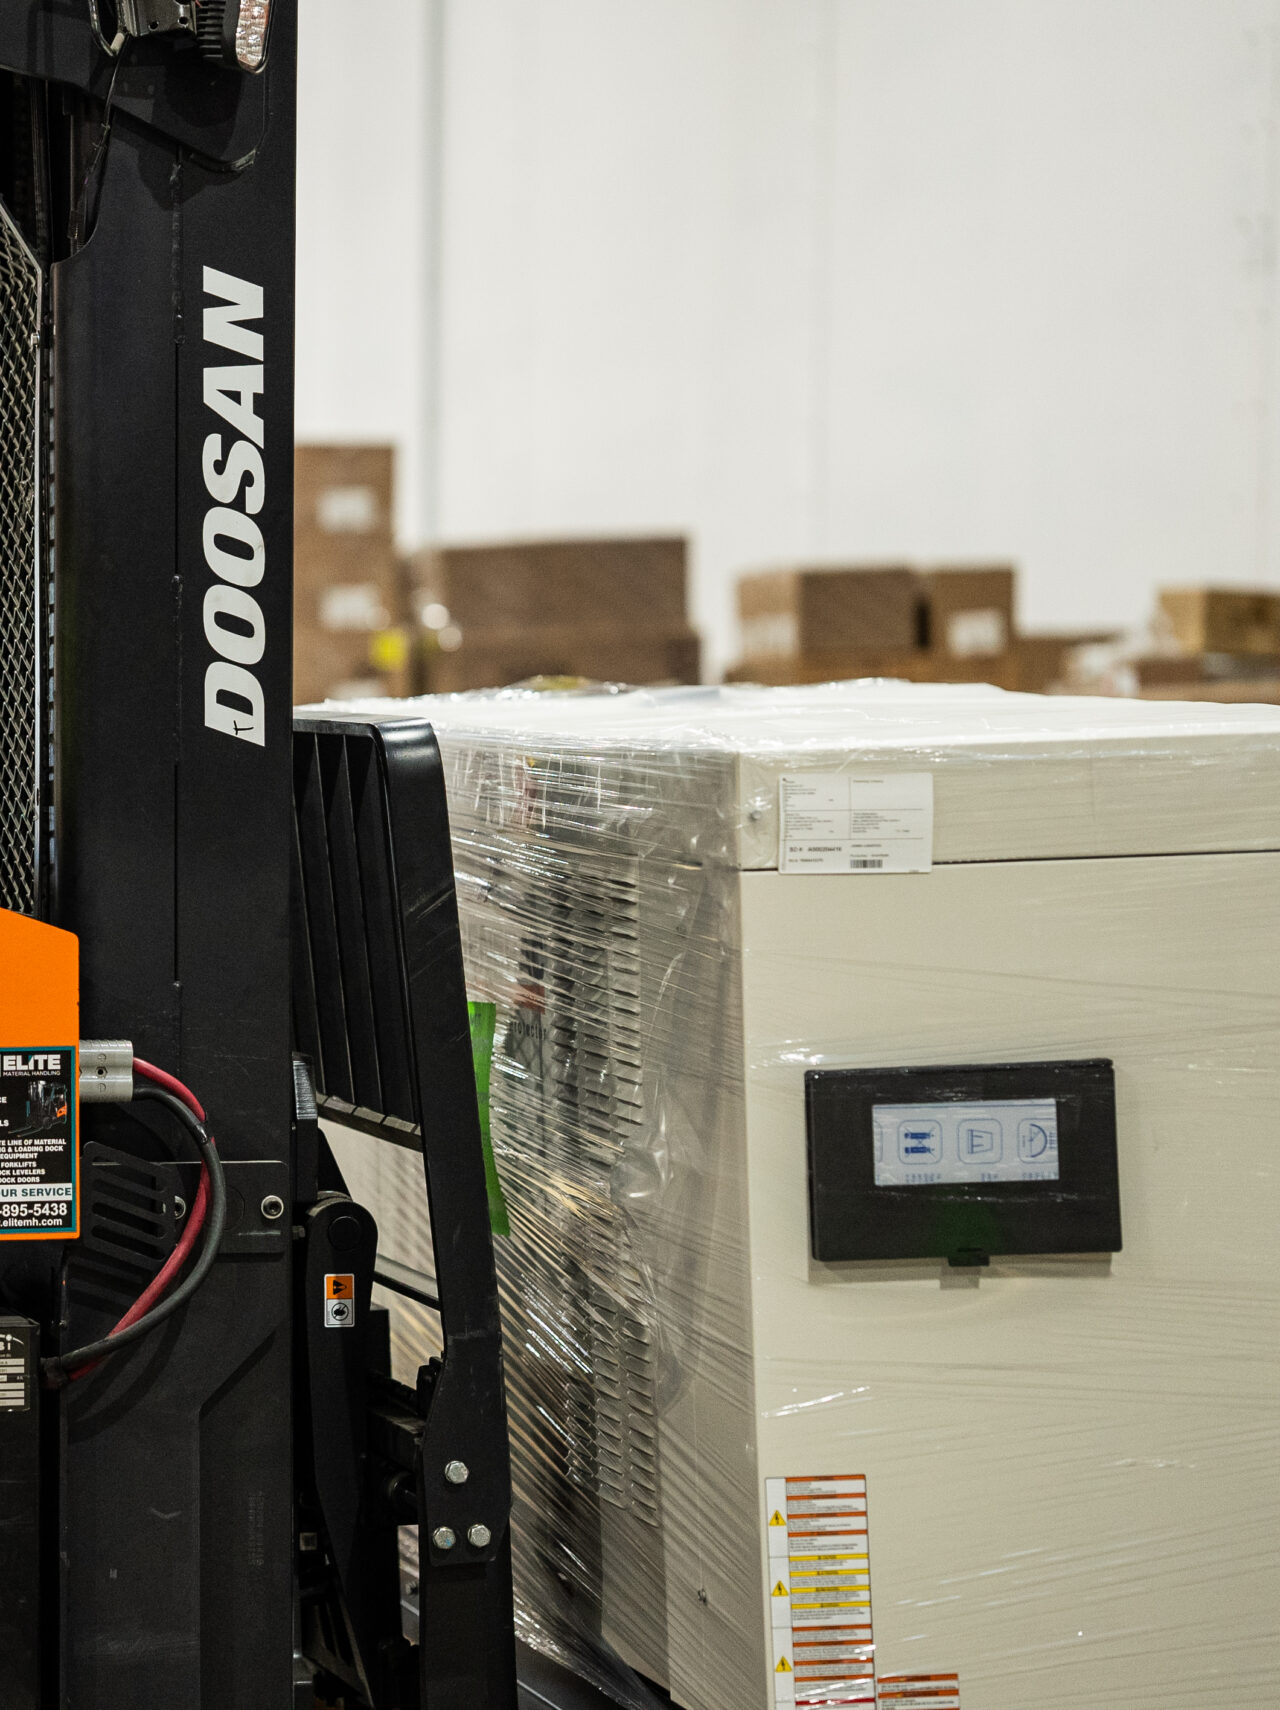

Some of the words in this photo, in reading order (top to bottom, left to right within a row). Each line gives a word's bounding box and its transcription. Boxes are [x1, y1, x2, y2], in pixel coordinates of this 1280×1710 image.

[202, 265, 265, 746] DOOSAN
[3, 1054, 61, 1071] ELITE
[22, 1188, 72, 1197] SERVICE
